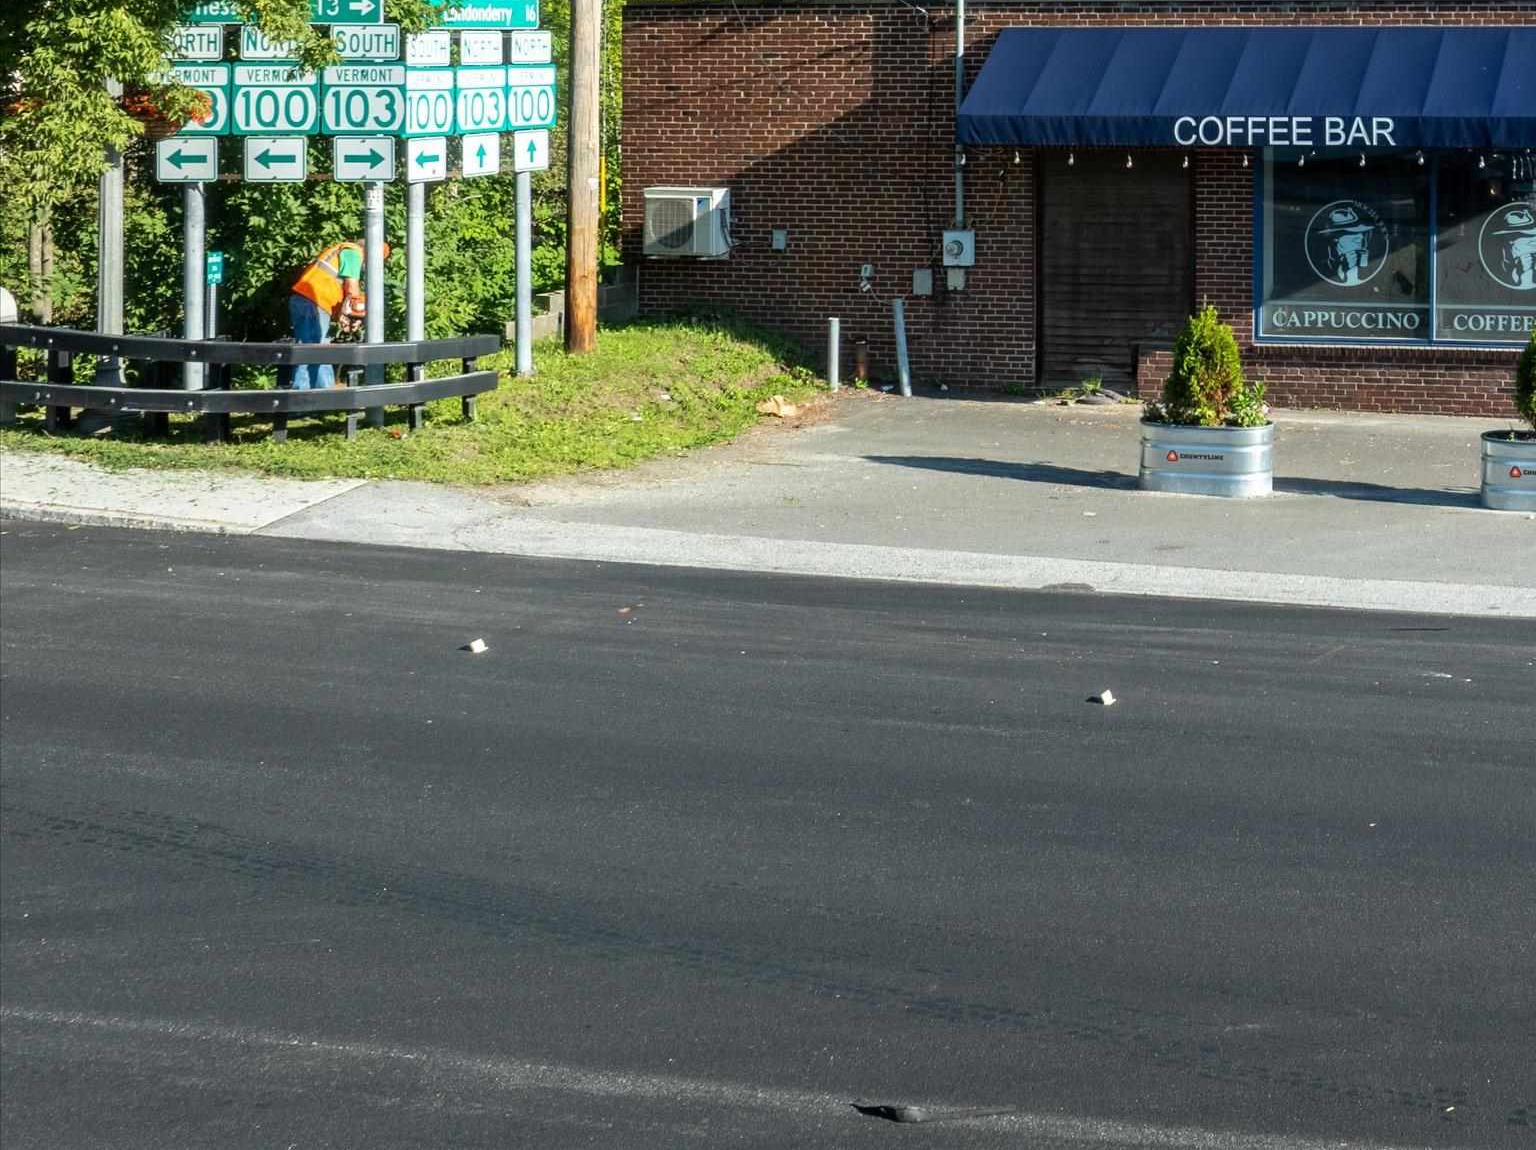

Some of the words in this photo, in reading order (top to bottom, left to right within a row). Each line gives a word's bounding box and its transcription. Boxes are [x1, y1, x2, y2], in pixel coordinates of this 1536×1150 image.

[525, 4, 536, 22] 16
[173, 33, 218, 53] ORTH
[335, 30, 395, 53] SOUTH
[336, 68, 393, 83] VERMONT
[241, 89, 309, 128] 100
[331, 89, 397, 129] 103
[408, 94, 448, 130] 100
[463, 91, 500, 126] 103
[513, 89, 550, 123] 100
[1173, 115, 1313, 146] COFFEE
[1325, 116, 1397, 147] BAR
[1272, 309, 1420, 330] CAPPUCCINO
[1453, 313, 1535, 332] COFFEE
